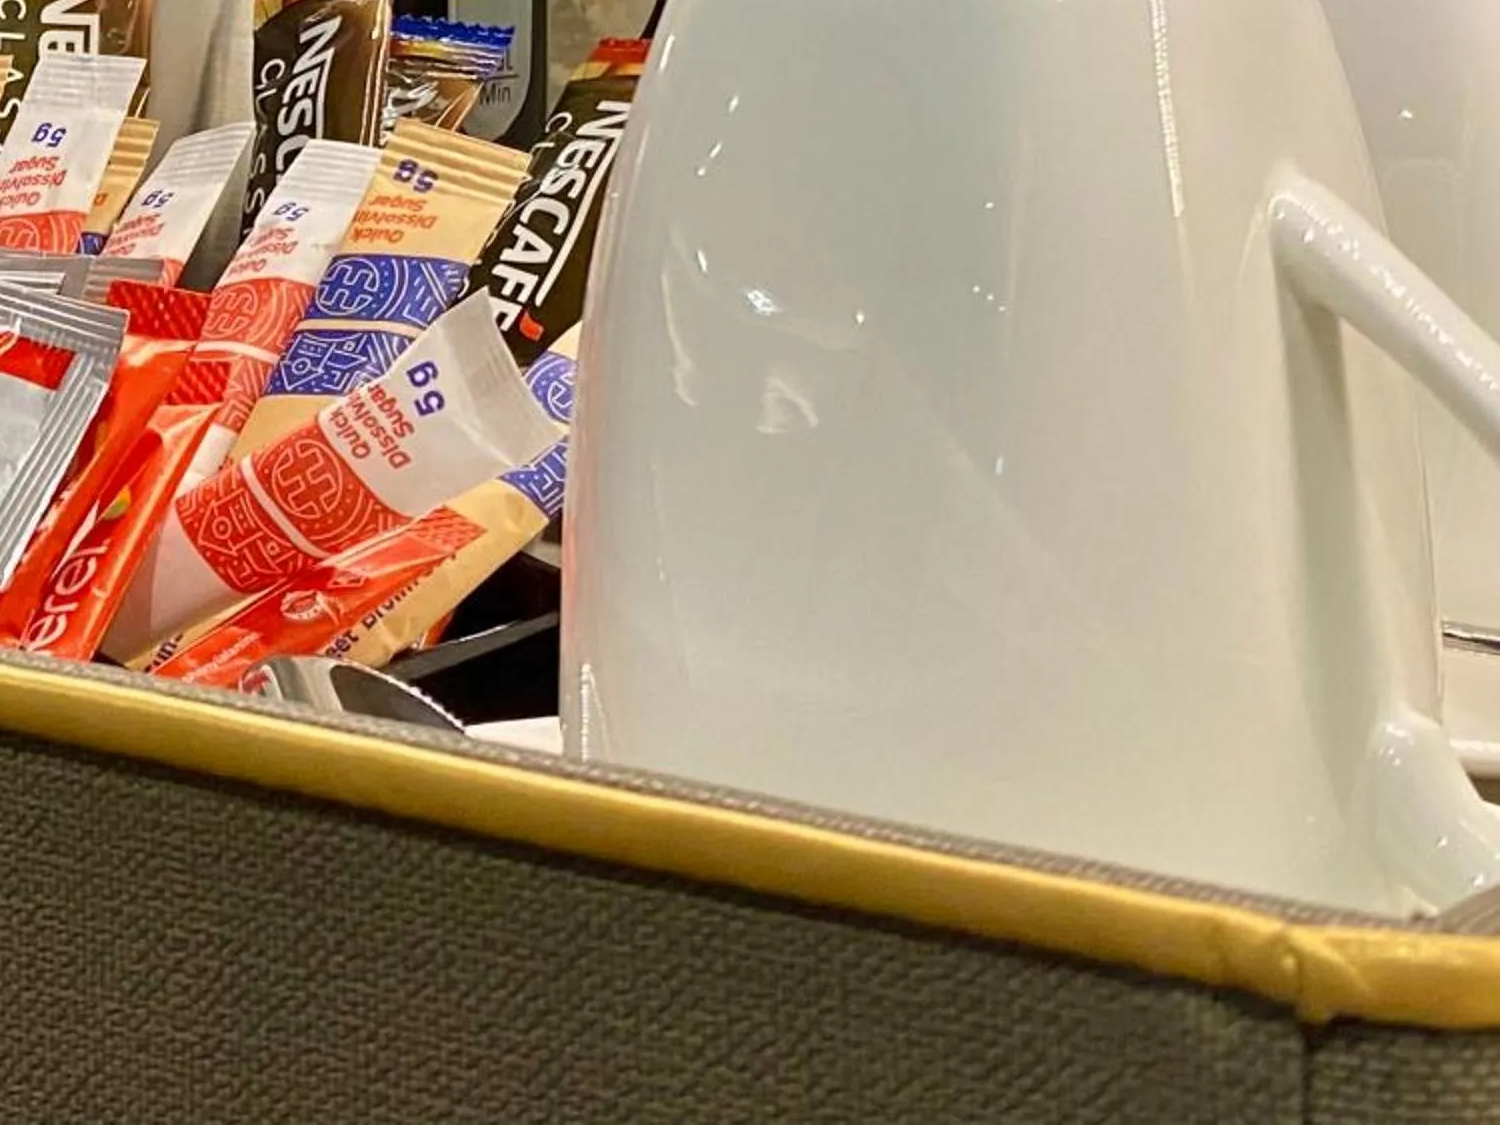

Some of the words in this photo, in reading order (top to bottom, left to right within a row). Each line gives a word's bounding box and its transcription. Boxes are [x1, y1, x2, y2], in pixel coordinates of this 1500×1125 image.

[480, 84, 511, 107] Min
[30, 122, 67, 148] 5g
[8, 156, 61, 174] Sugar
[273, 202, 309, 222] 5g
[368, 194, 428, 213] Sugar
[349, 226, 405, 244] Quick
[405, 360, 445, 417] 5g
[367, 383, 416, 439] Sugar
